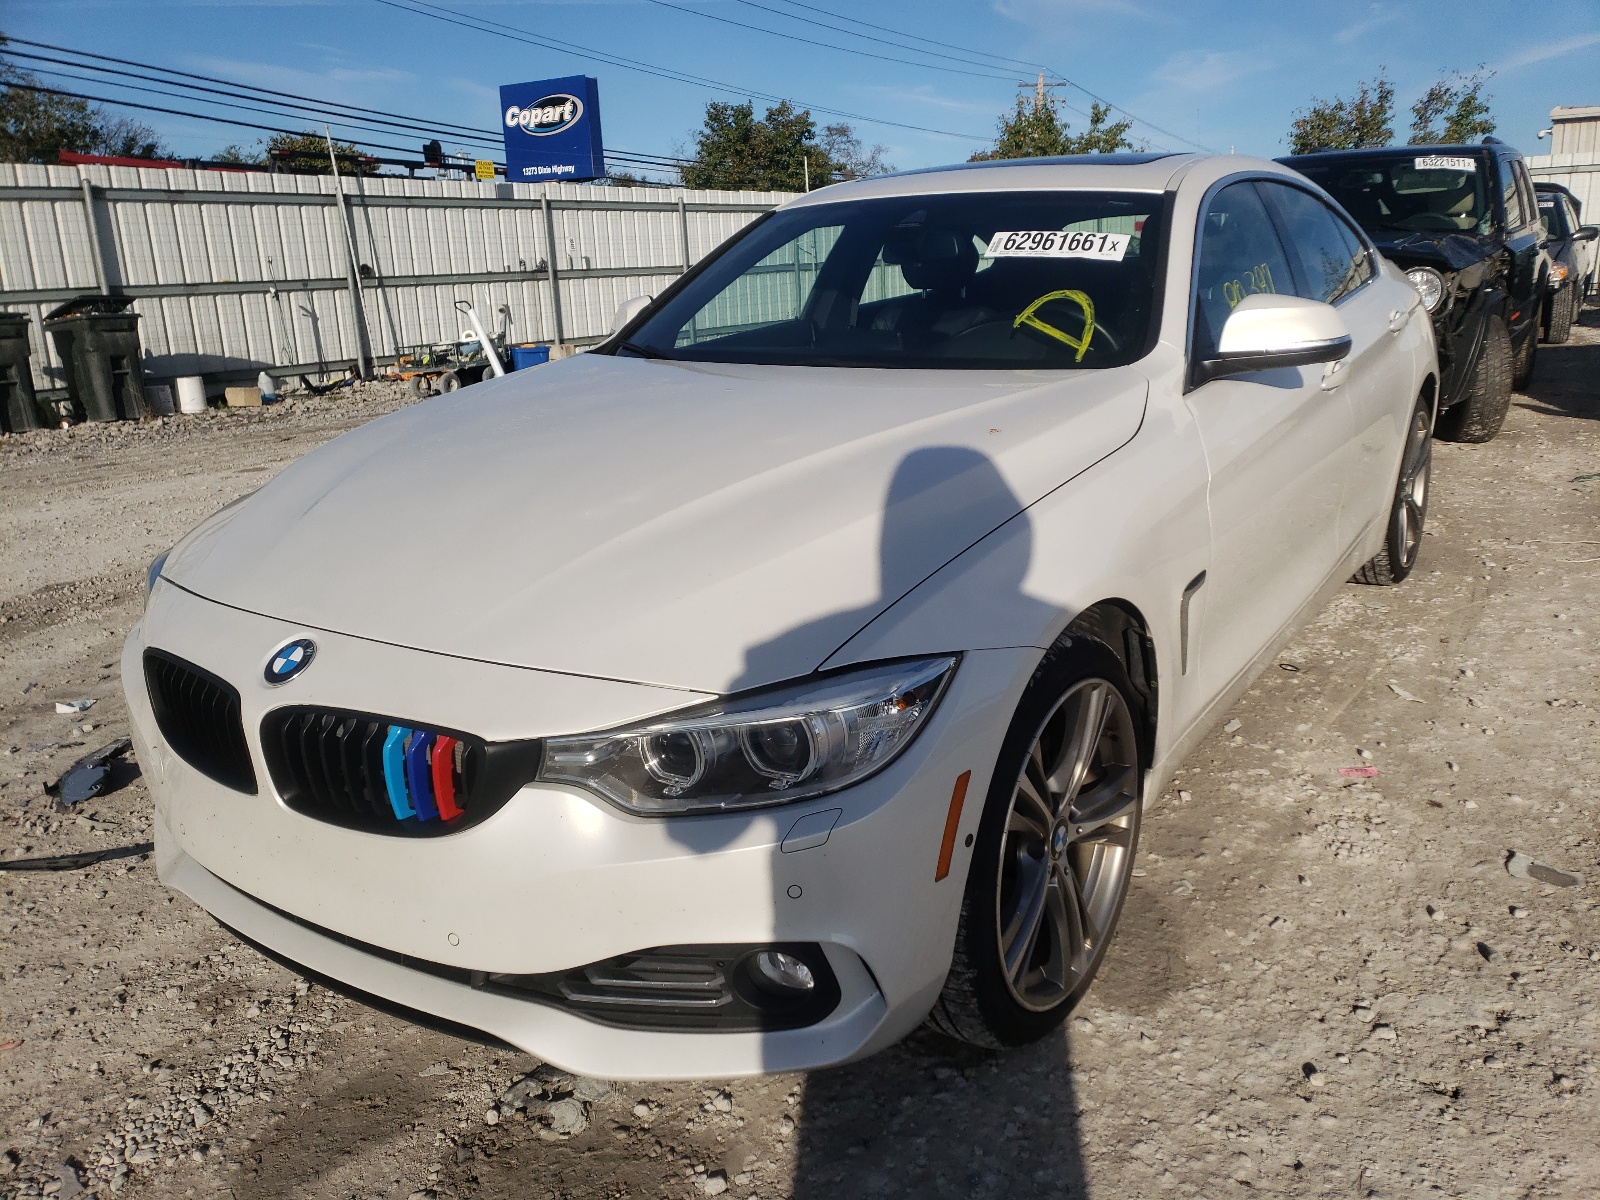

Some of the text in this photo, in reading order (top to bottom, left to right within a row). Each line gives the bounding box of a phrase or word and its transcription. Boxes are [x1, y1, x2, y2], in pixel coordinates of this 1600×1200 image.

[505, 98, 573, 129] Copart
[522, 164, 575, 176] 13273 Dixie Highway
